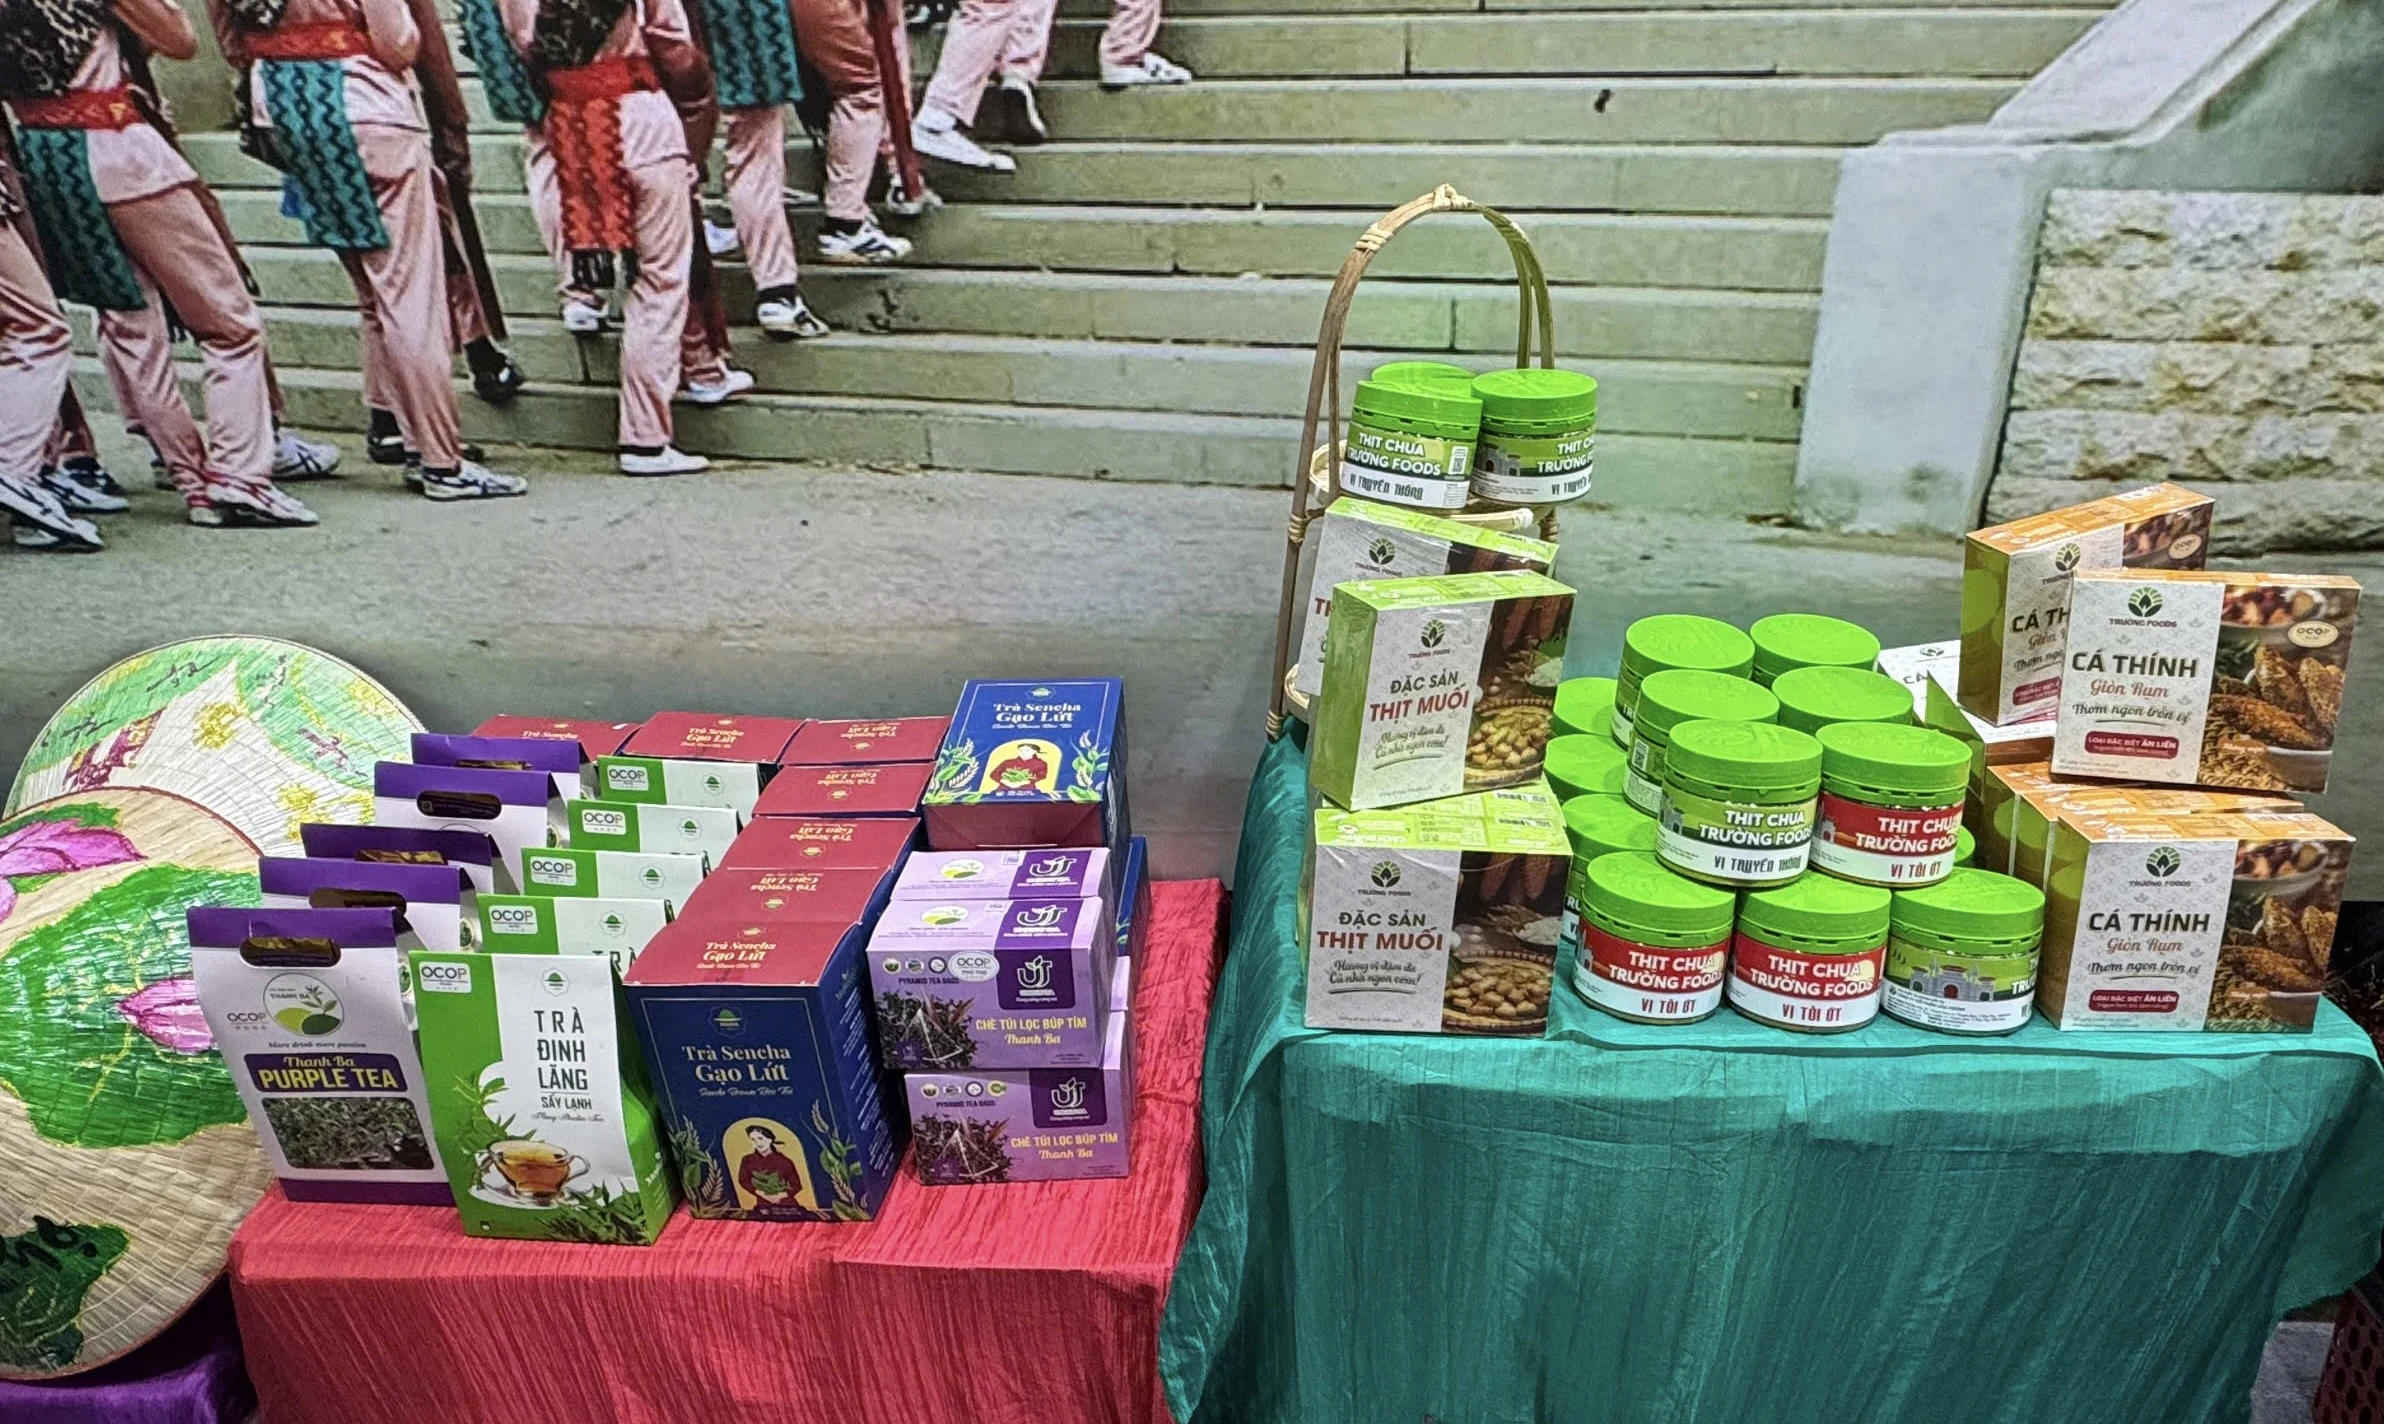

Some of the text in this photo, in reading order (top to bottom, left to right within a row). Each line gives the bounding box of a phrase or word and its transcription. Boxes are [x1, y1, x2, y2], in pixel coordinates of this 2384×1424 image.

[1385, 439, 1424, 456] CHUA
[1392, 457, 1441, 476] FOODS
[2012, 608, 2040, 633] CÁ
[2072, 648, 2198, 678] CÁ THÍNH
[1370, 682, 1470, 725] THỊT MUỐI
[608, 768, 646, 782] OCOP
[584, 812, 623, 824] OCOP
[1767, 811, 1805, 827] CHUA
[1699, 824, 1773, 846] TRƯỜNG
[1856, 832, 1928, 853] TRƯỜNG
[531, 860, 574, 874] OCOP
[491, 909, 534, 922] OCOP
[1338, 909, 1426, 930] ĐẶC SẢN
[2088, 908, 2211, 932] CÁ THÍNH
[1317, 926, 1443, 955] THỊT MUỐI
[421, 966, 467, 979] OCOP
[956, 957, 991, 969] OCOP
[1812, 963, 1860, 979] CHUA
[1608, 964, 1679, 990] TRƯỜNG
[1750, 968, 1873, 997] TRƯỜNG FOODS
[227, 1013, 267, 1022] OCOP
[533, 1007, 585, 1035] TRÀ
[1004, 1032, 1061, 1045] Thanh Ba
[537, 1039, 586, 1062] ĐINH
[681, 1044, 792, 1061] Trà Sencha
[283, 1055, 355, 1068] Thanh Ba
[258, 1068, 399, 1089] PURPLE TEA
[537, 1065, 588, 1090] LĂNG
[695, 1061, 790, 1086] Gạo Lứt
